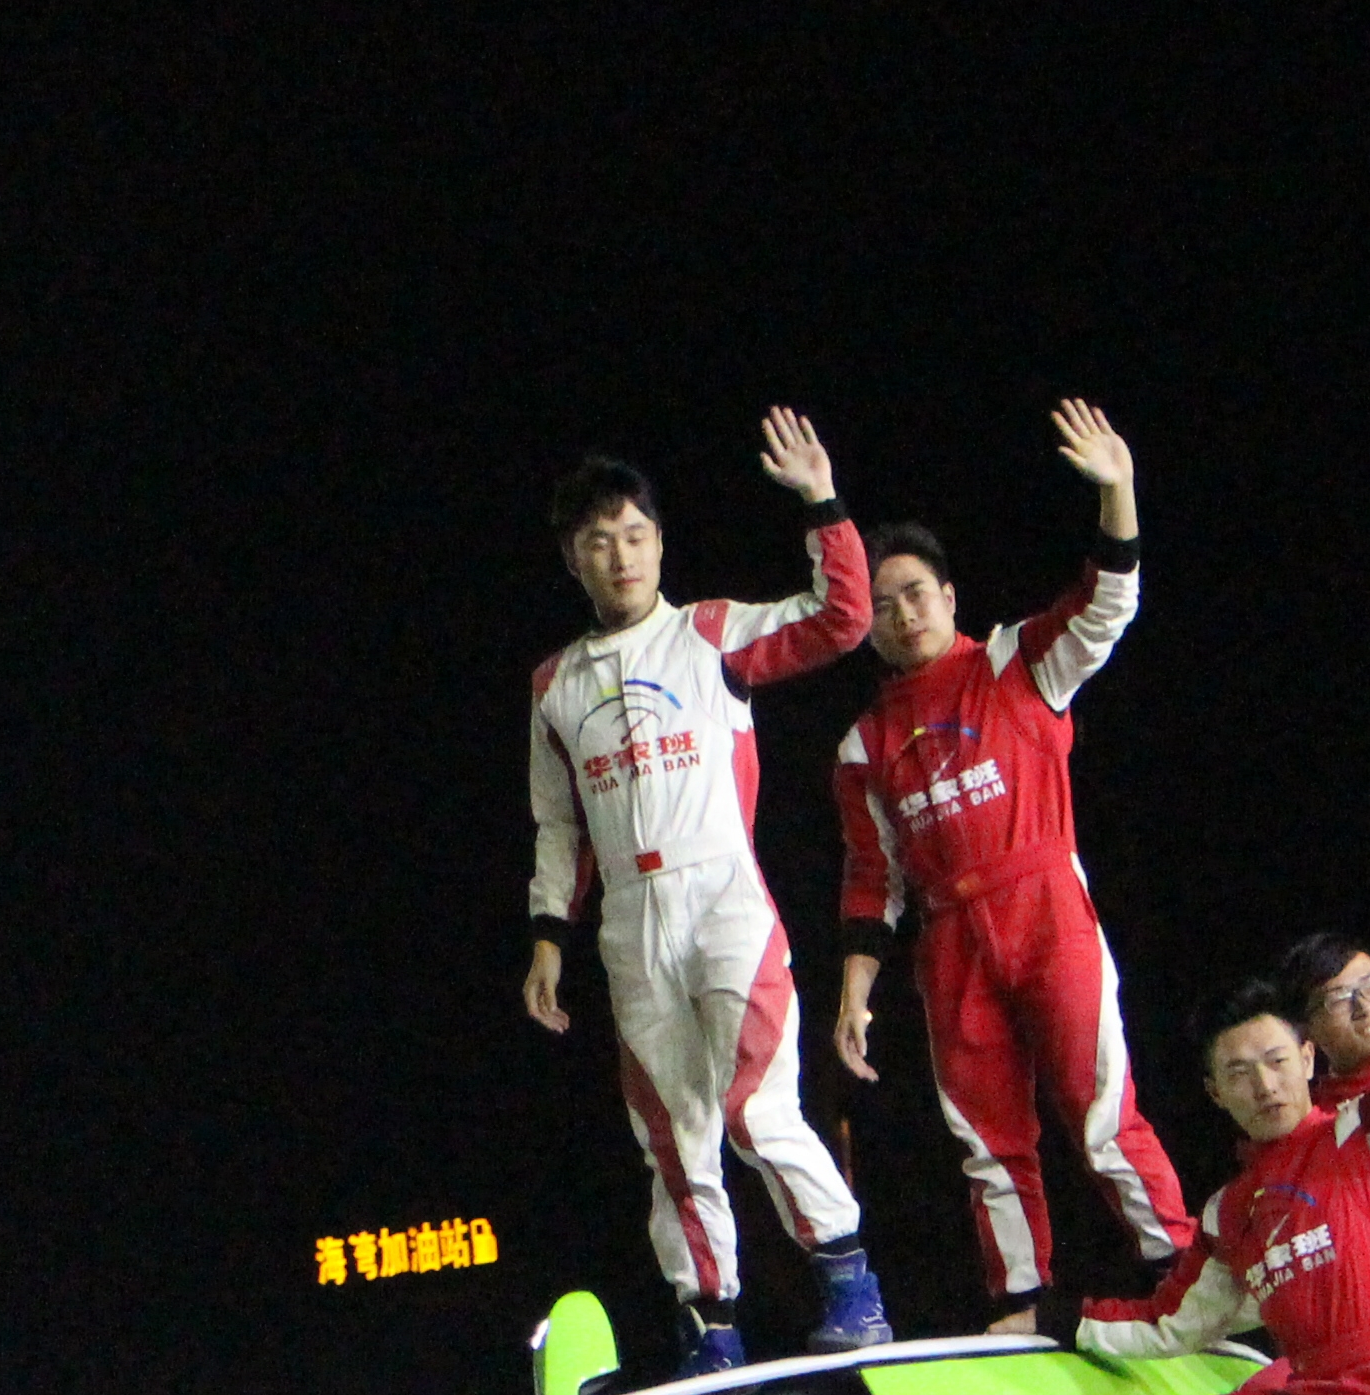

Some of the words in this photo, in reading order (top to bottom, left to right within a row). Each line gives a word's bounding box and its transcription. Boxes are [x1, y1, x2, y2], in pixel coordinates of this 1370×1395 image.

[663, 753, 701, 772] BAN
[969, 780, 1007, 806] BAN
[1272, 1267, 1295, 1287] JIA
[1300, 1246, 1337, 1272] BAN
